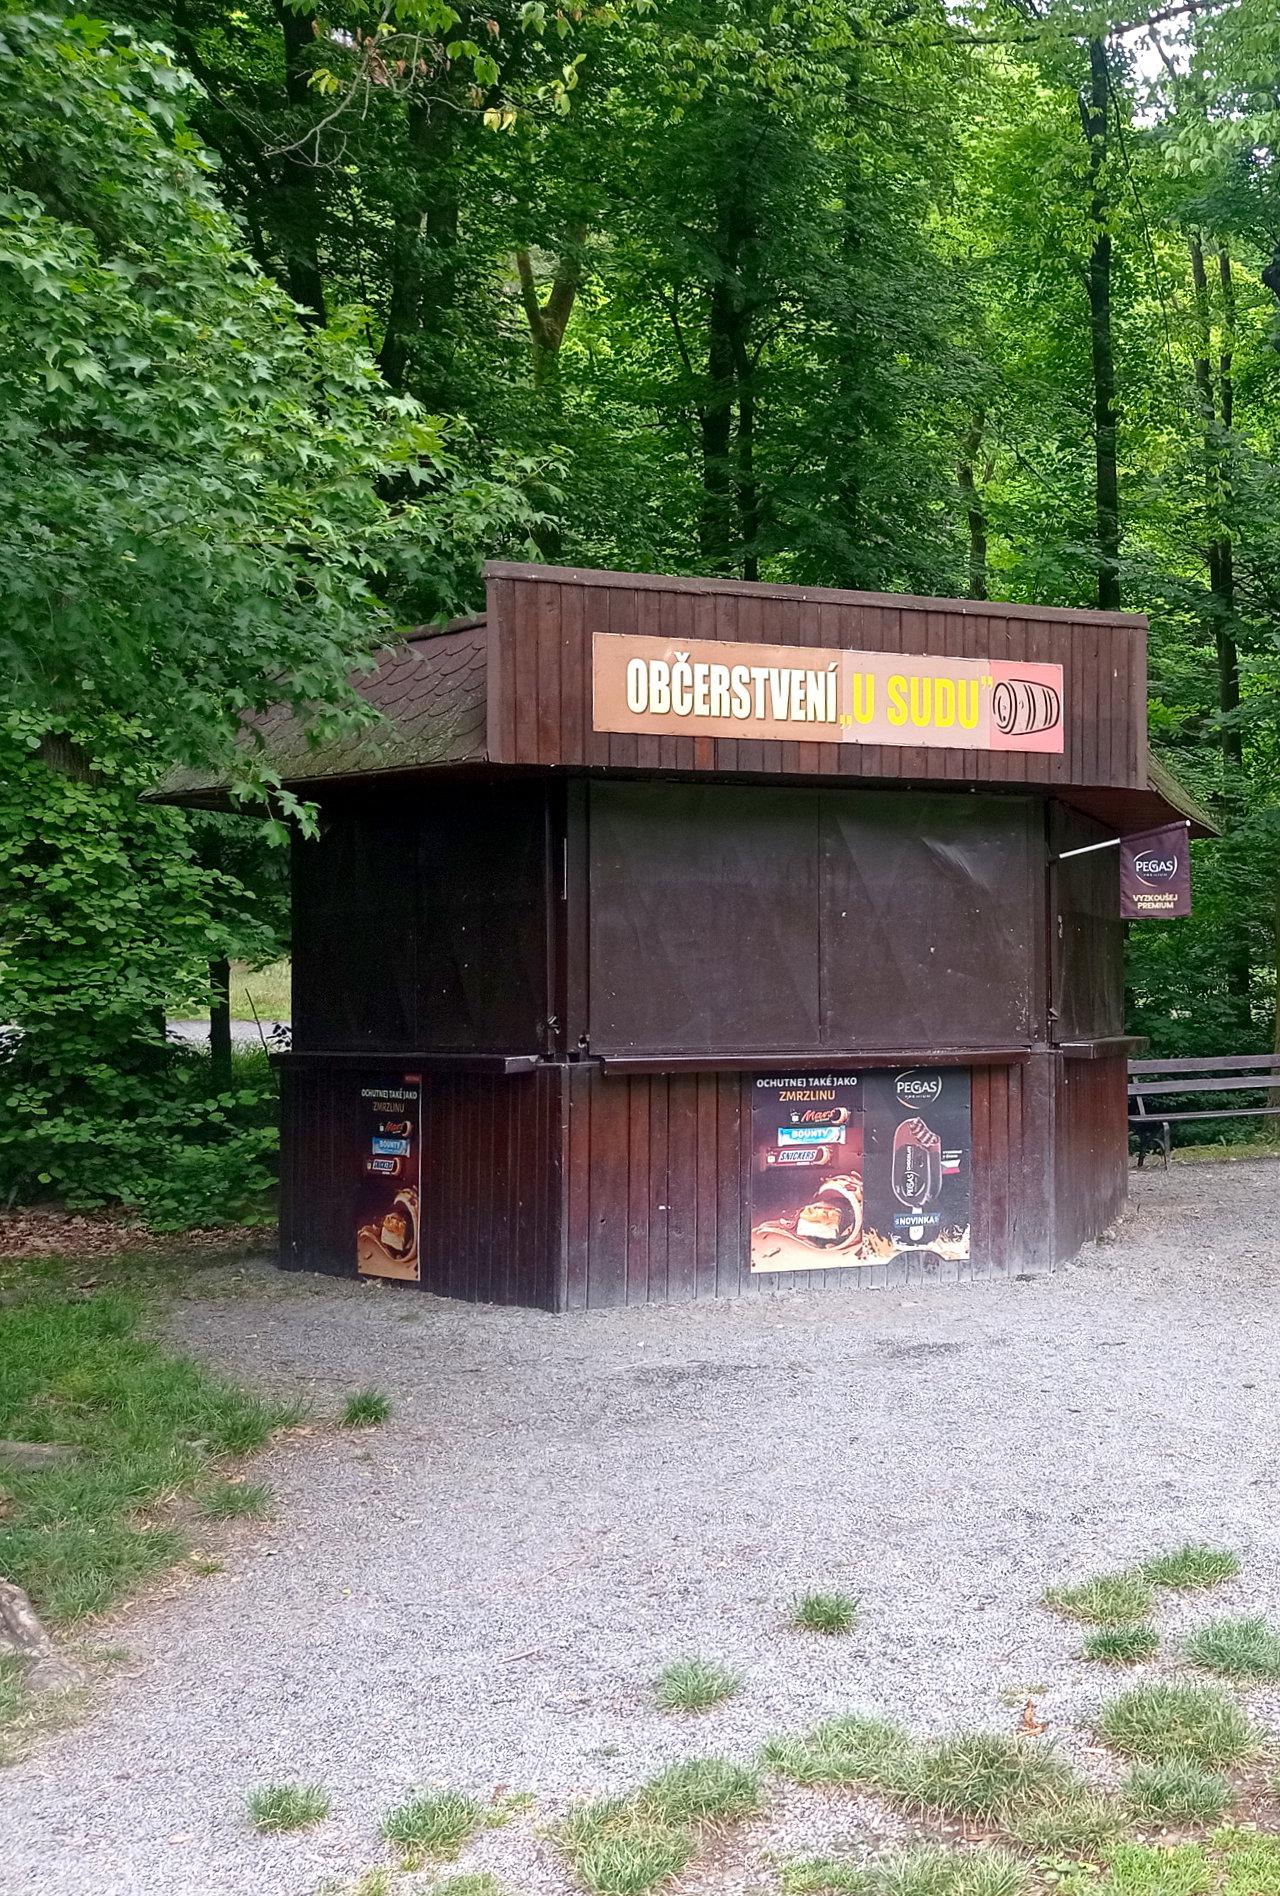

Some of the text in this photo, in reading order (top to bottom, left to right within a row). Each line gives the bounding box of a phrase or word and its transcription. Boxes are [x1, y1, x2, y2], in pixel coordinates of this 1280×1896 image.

[626, 651, 838, 723] OBČERSTVENÍ
[1136, 861, 1173, 872] PEGAS
[1133, 892, 1178, 902] VYZKOUŠEJ
[756, 1074, 858, 1088] OCHUTNEJ TAKÉ JAKO
[361, 1087, 417, 1099] OCHUTNEJ TAKÉ JAKO
[897, 1081, 937, 1094] PEGAS
[779, 1090, 836, 1102] ZMRZLINU
[800, 1108, 835, 1122] Mars
[792, 1128, 829, 1139] BOUNTY
[780, 1150, 816, 1161] SNICKERS
[900, 1214, 934, 1226] NOVINKA
